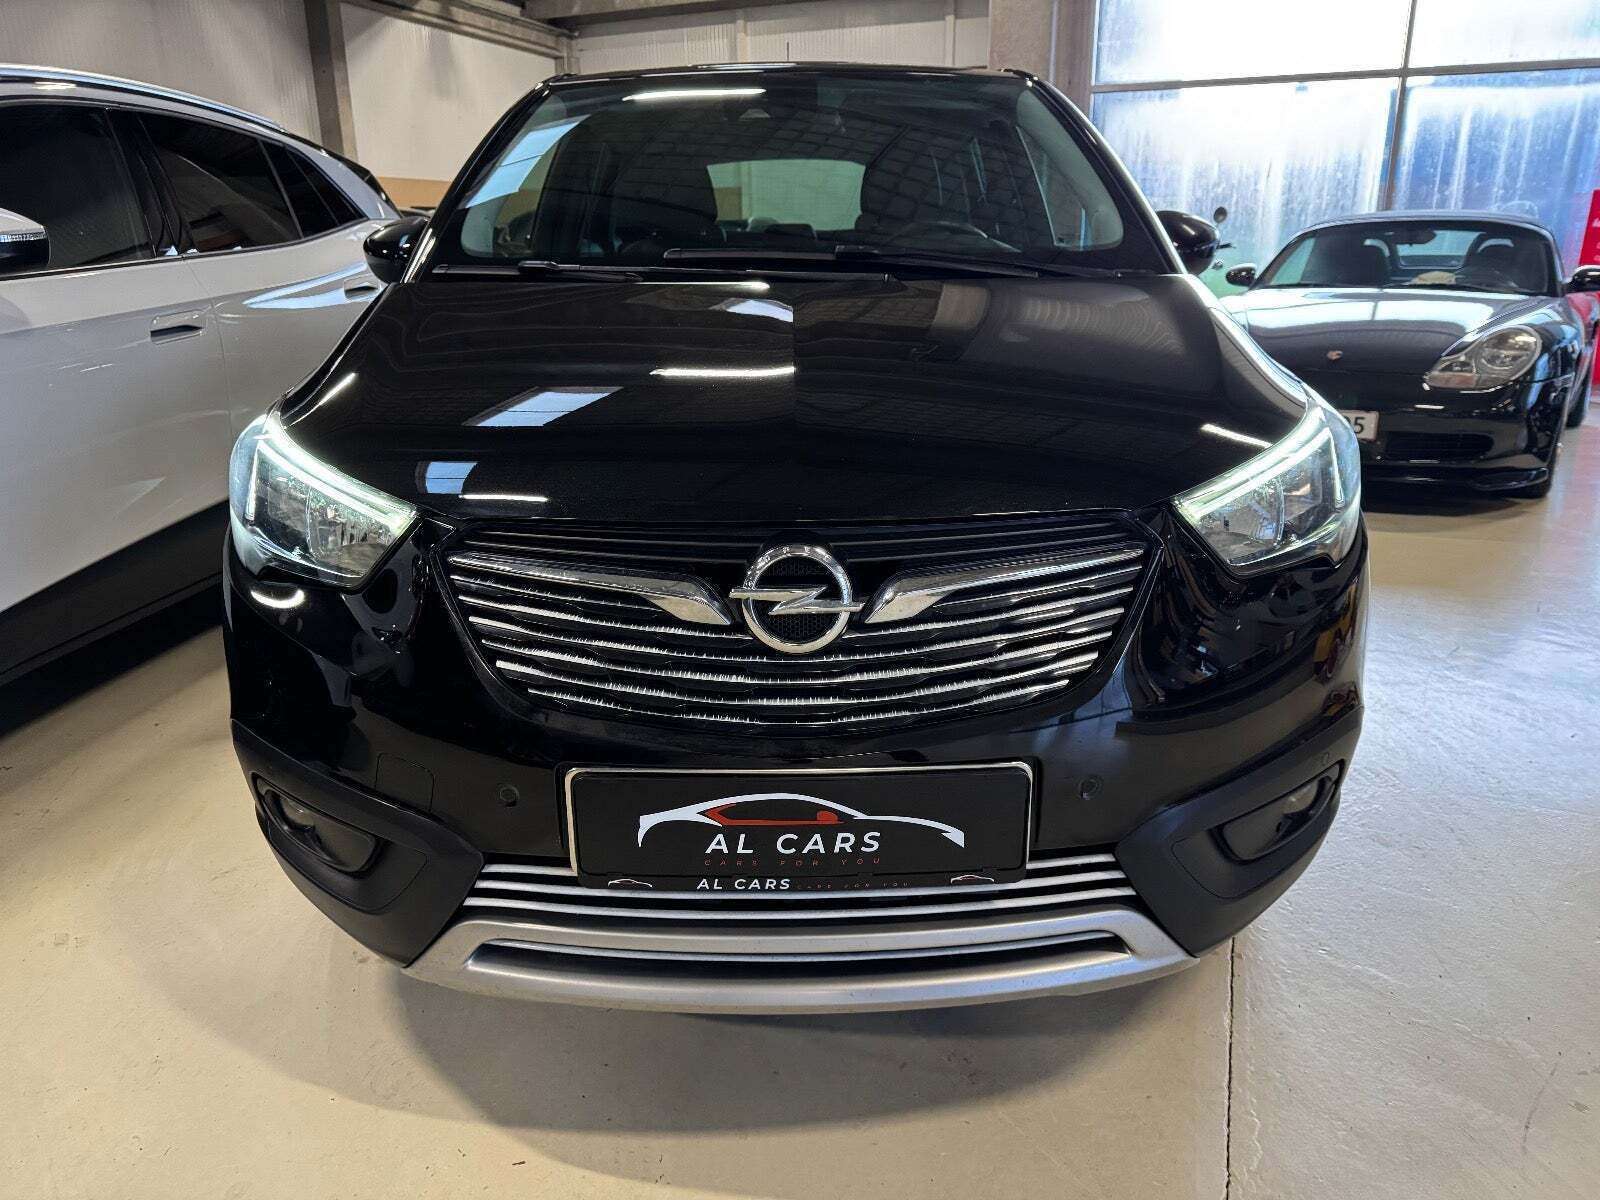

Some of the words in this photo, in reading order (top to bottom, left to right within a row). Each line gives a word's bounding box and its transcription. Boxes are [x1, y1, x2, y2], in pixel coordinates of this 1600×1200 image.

[705, 833, 754, 854] AL
[776, 831, 880, 854] CARS
[697, 878, 722, 890] AL
[734, 878, 791, 890] CARS
